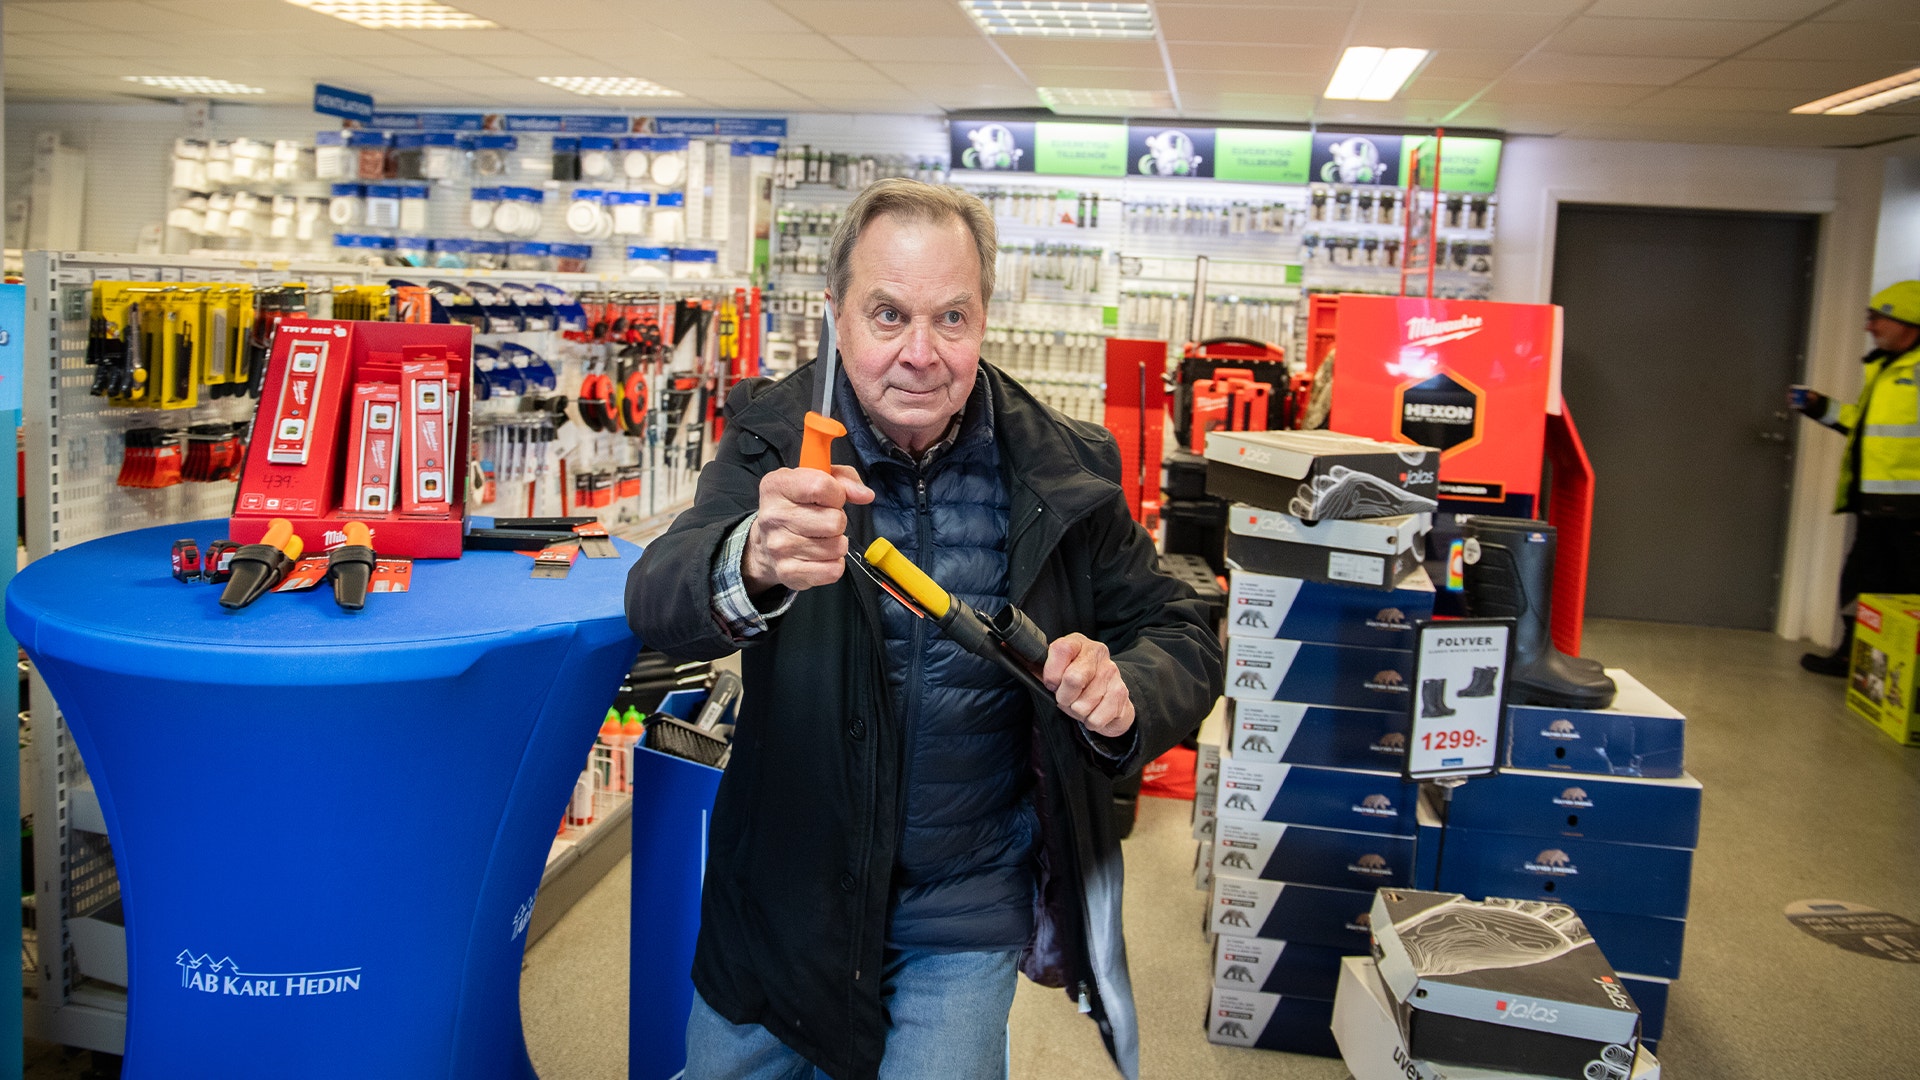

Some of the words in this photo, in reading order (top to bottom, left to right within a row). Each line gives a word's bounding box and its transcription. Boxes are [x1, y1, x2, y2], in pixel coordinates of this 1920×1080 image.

[281, 325, 309, 333] TRY
[310, 327, 333, 335] ME
[1406, 314, 1483, 340] Milwaukee
[1404, 403, 1474, 420] HEXON
[1403, 469, 1434, 488] jalas
[1253, 514, 1297, 534] jalas
[1437, 637, 1493, 647] POLYVER
[1421, 729, 1488, 751] 1299:-
[189, 971, 219, 993] AB
[223, 976, 280, 997] KARL
[285, 973, 361, 996] HEDIN
[1500, 998, 1559, 1023] jalas
